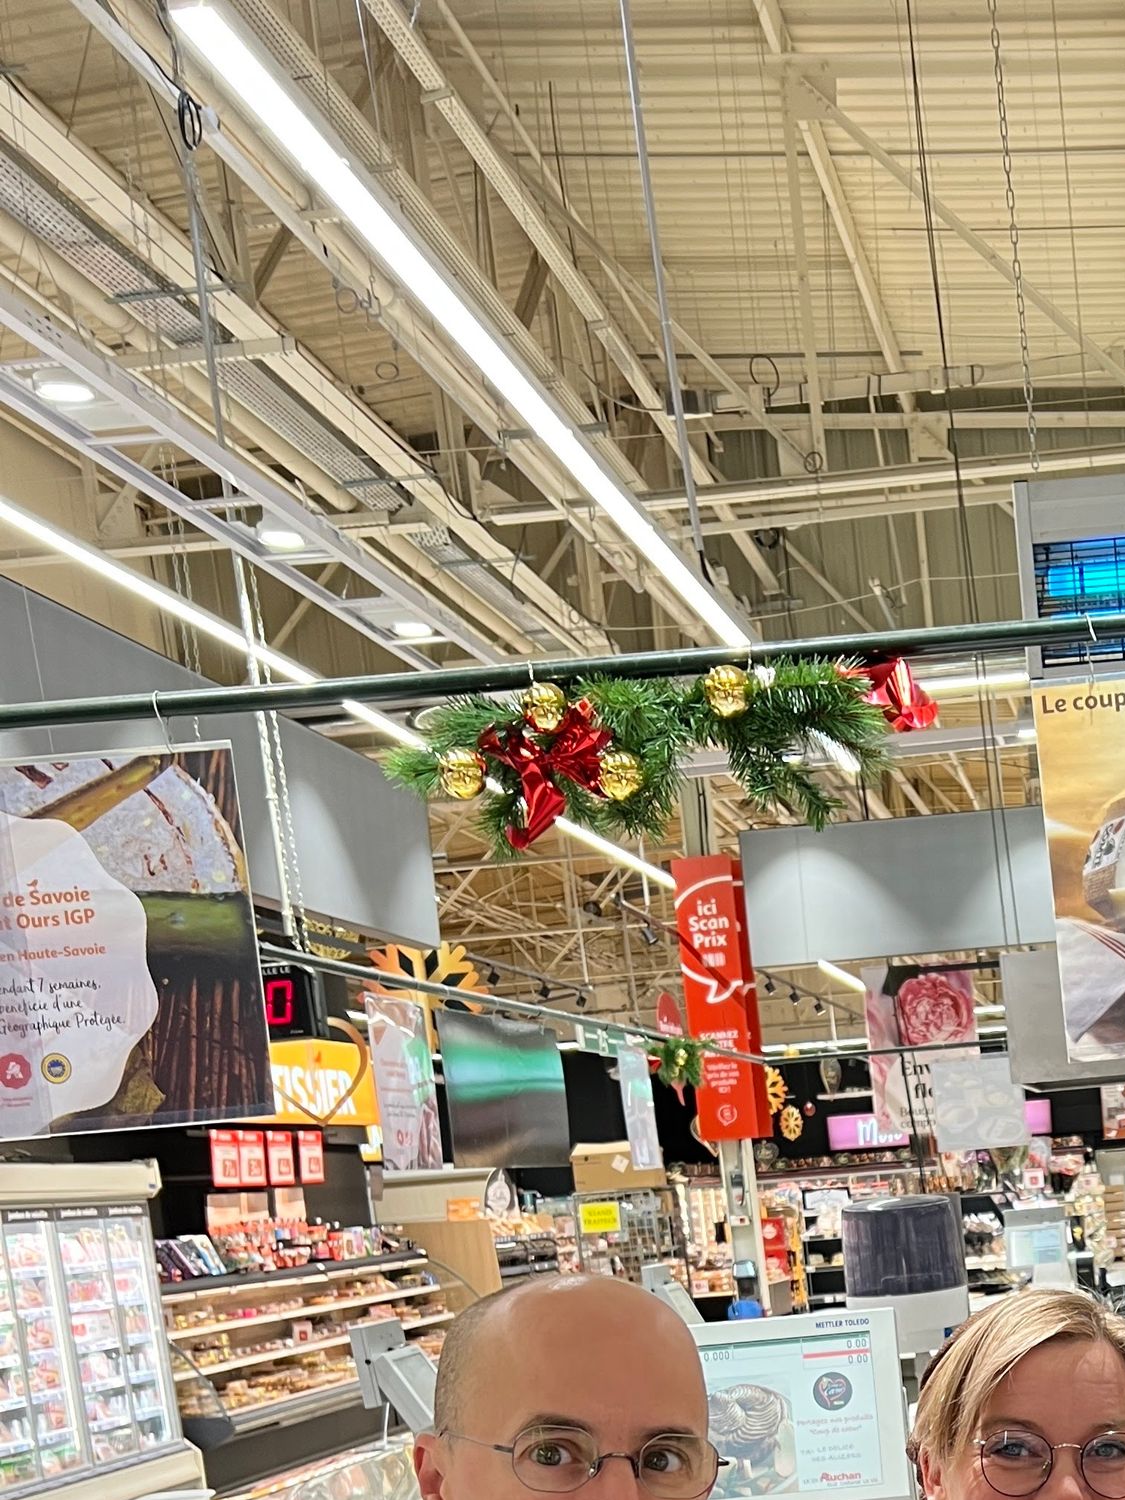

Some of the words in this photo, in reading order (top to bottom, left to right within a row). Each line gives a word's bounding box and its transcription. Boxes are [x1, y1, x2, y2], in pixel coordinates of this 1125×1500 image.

[1041, 694, 1067, 715] Le
[3, 890, 25, 908] de
[29, 886, 91, 906] Savoie
[16, 912, 60, 929] Ours
[64, 908, 95, 925] IGP
[688, 915, 729, 931] Scan
[692, 931, 727, 949] Prix
[18, 943, 106, 962] Haute-Savoie
[38, 978, 44, 993] 7
[53, 995, 83, 1012] d'une
[815, 1320, 843, 1330] METTLER
[845, 1318, 870, 1328] TOLEDO
[820, 1472, 862, 1482] Auchan
